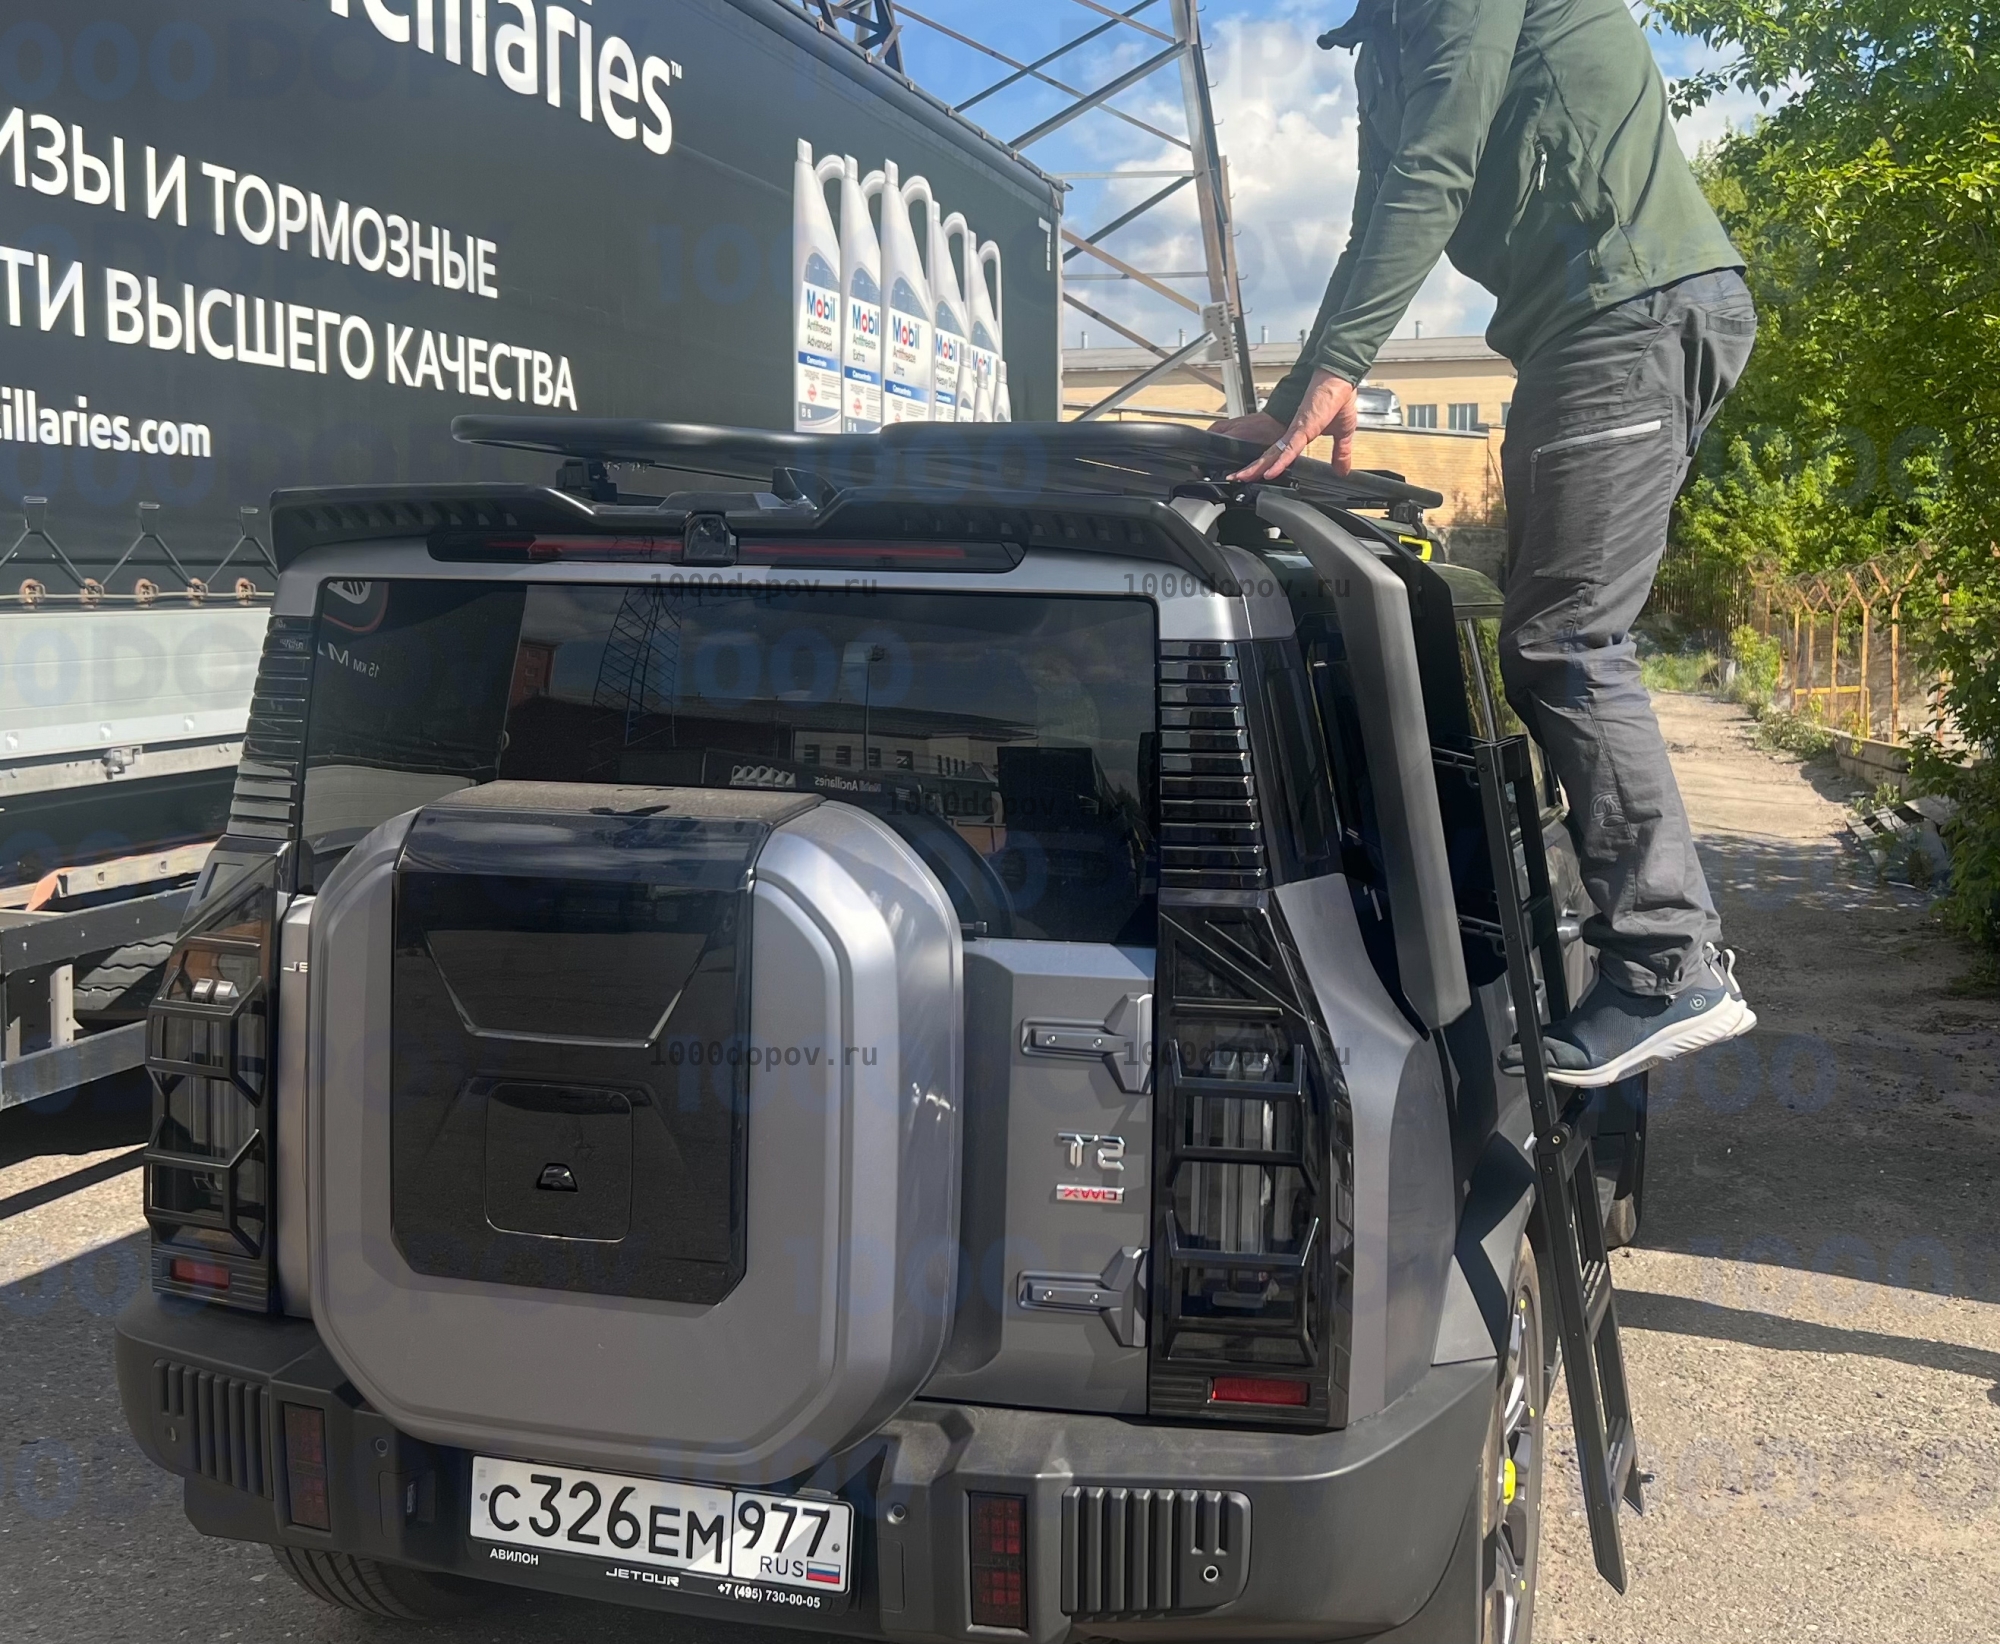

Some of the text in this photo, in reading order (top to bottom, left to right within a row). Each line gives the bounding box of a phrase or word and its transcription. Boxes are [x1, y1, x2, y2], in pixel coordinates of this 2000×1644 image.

[146, 145, 188, 227] И
[201, 161, 499, 299] ТОРМОЗНЫЕ
[807, 289, 836, 322] Mobil
[852, 304, 880, 336] Mobil
[106, 267, 375, 381] ВЫСШЕГО
[387, 322, 578, 411] КАЧЕСТВА
[892, 315, 920, 350] Mobil
[936, 333, 958, 362] Mobil
[0, 386, 211, 458] illaries.com
[1058, 1132, 1125, 1171] T2
[738, 1500, 830, 1558] 977
[489, 1548, 539, 1565] АВИЛОН
[760, 1555, 804, 1577] RUS
[606, 1567, 680, 1587] JETOUR
[717, 1583, 821, 1609] +7 (495) 730-00-05
